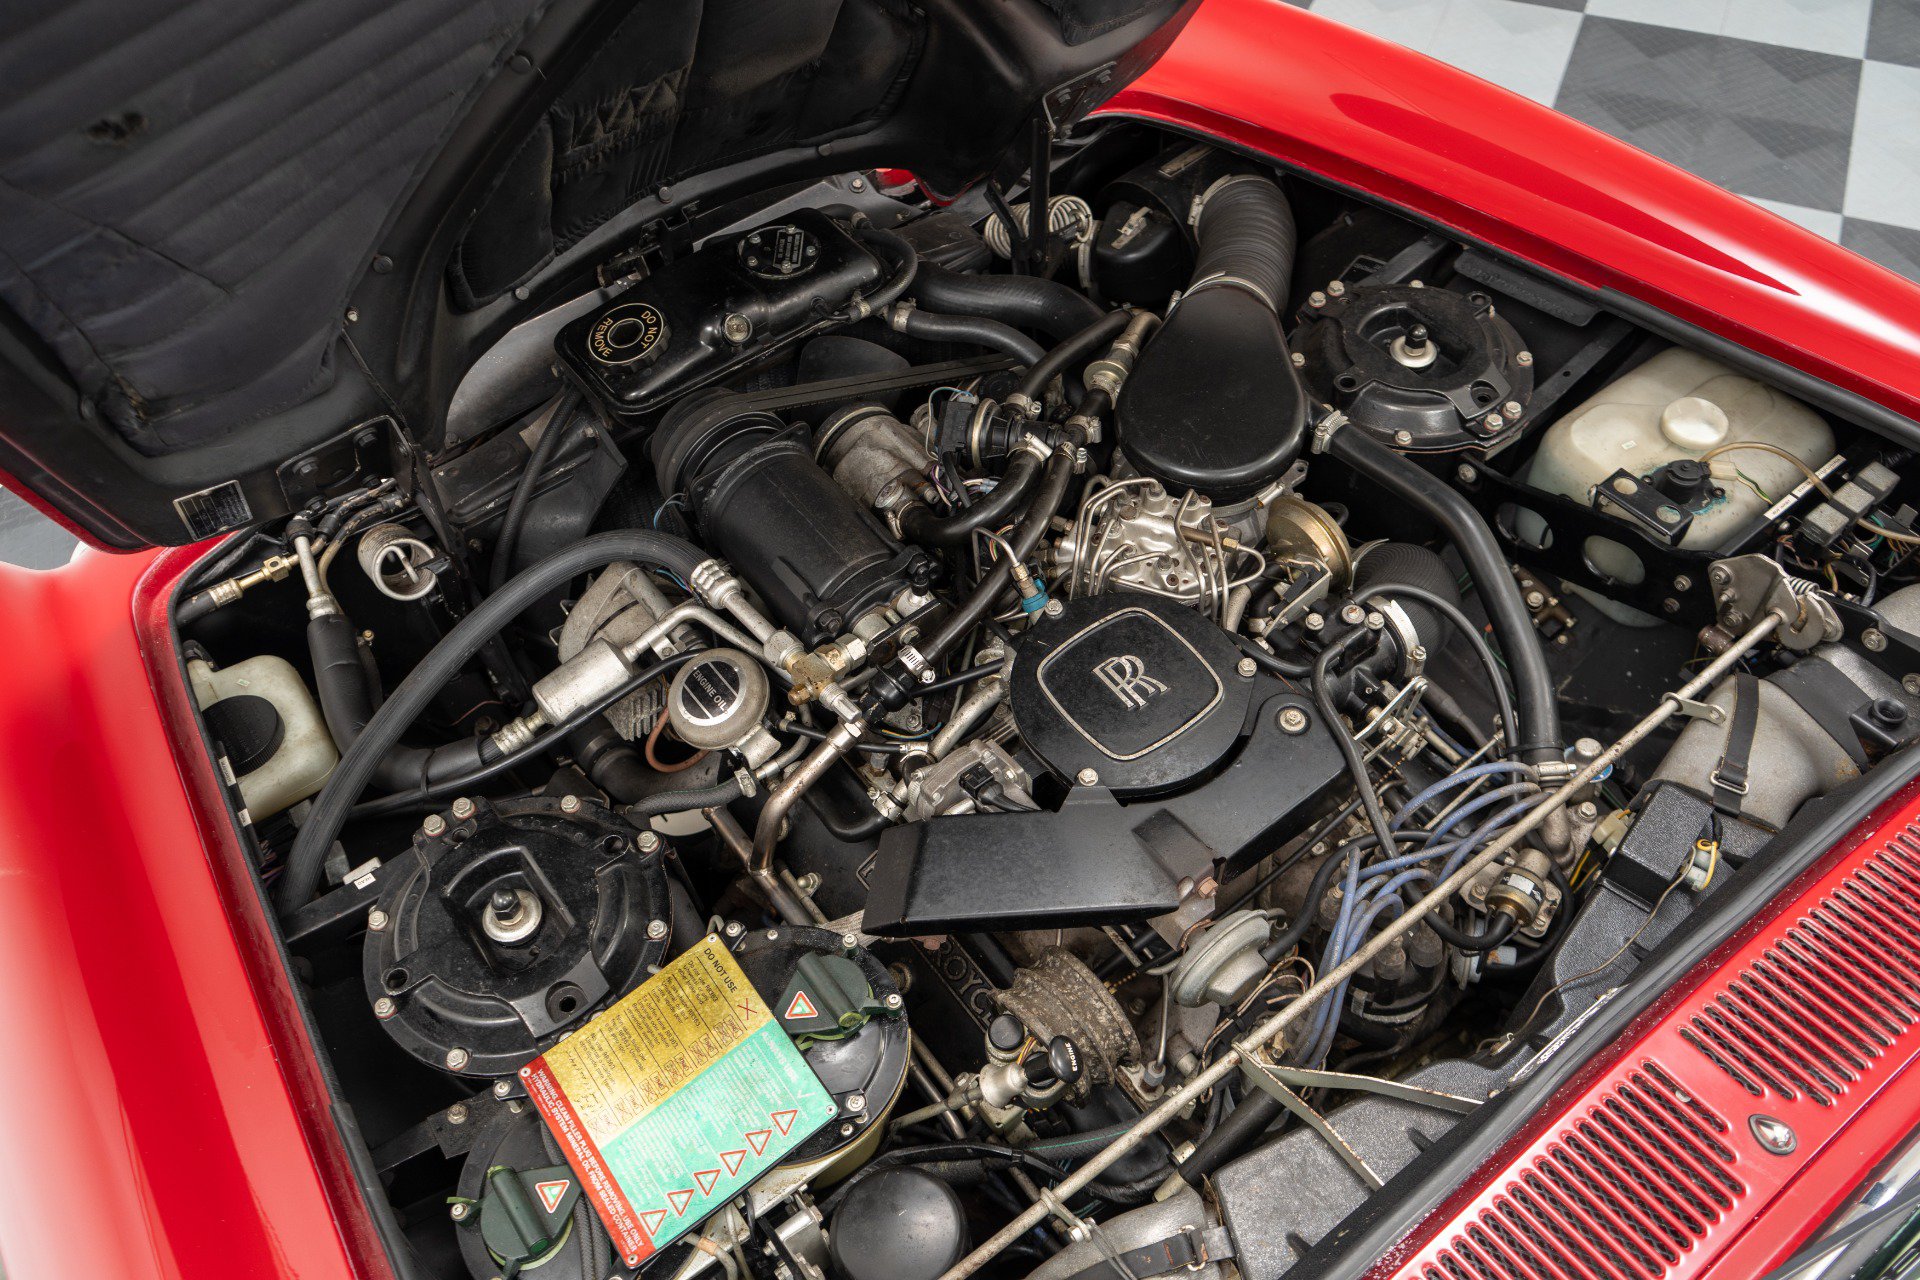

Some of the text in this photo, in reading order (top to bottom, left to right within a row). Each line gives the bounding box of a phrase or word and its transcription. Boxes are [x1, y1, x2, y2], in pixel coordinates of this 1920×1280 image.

[594, 318, 613, 357] REMOVE
[641, 311, 658, 349] DO NOT
[693, 670, 727, 711] ENGINE OIL
[703, 947, 738, 993] DO NOT USE
[1064, 1042, 1078, 1072] ENGINE
[530, 1072, 555, 1109] HYDRAULIC
[550, 1106, 569, 1133] SYSTEM
[564, 1130, 586, 1161] MINERAL
[581, 1159, 592, 1172] OIL
[587, 1169, 603, 1191] FROM
[597, 1188, 617, 1216] SEALED
[611, 1213, 638, 1252] CONTAINER
[555, 1099, 571, 1121] CLEAN
[566, 1119, 583, 1141] FILLER
[578, 1139, 592, 1158] PLUG
[587, 1155, 606, 1182] BEFORE
[621, 1214, 634, 1230] USE
[629, 1227, 645, 1248] ONLY
